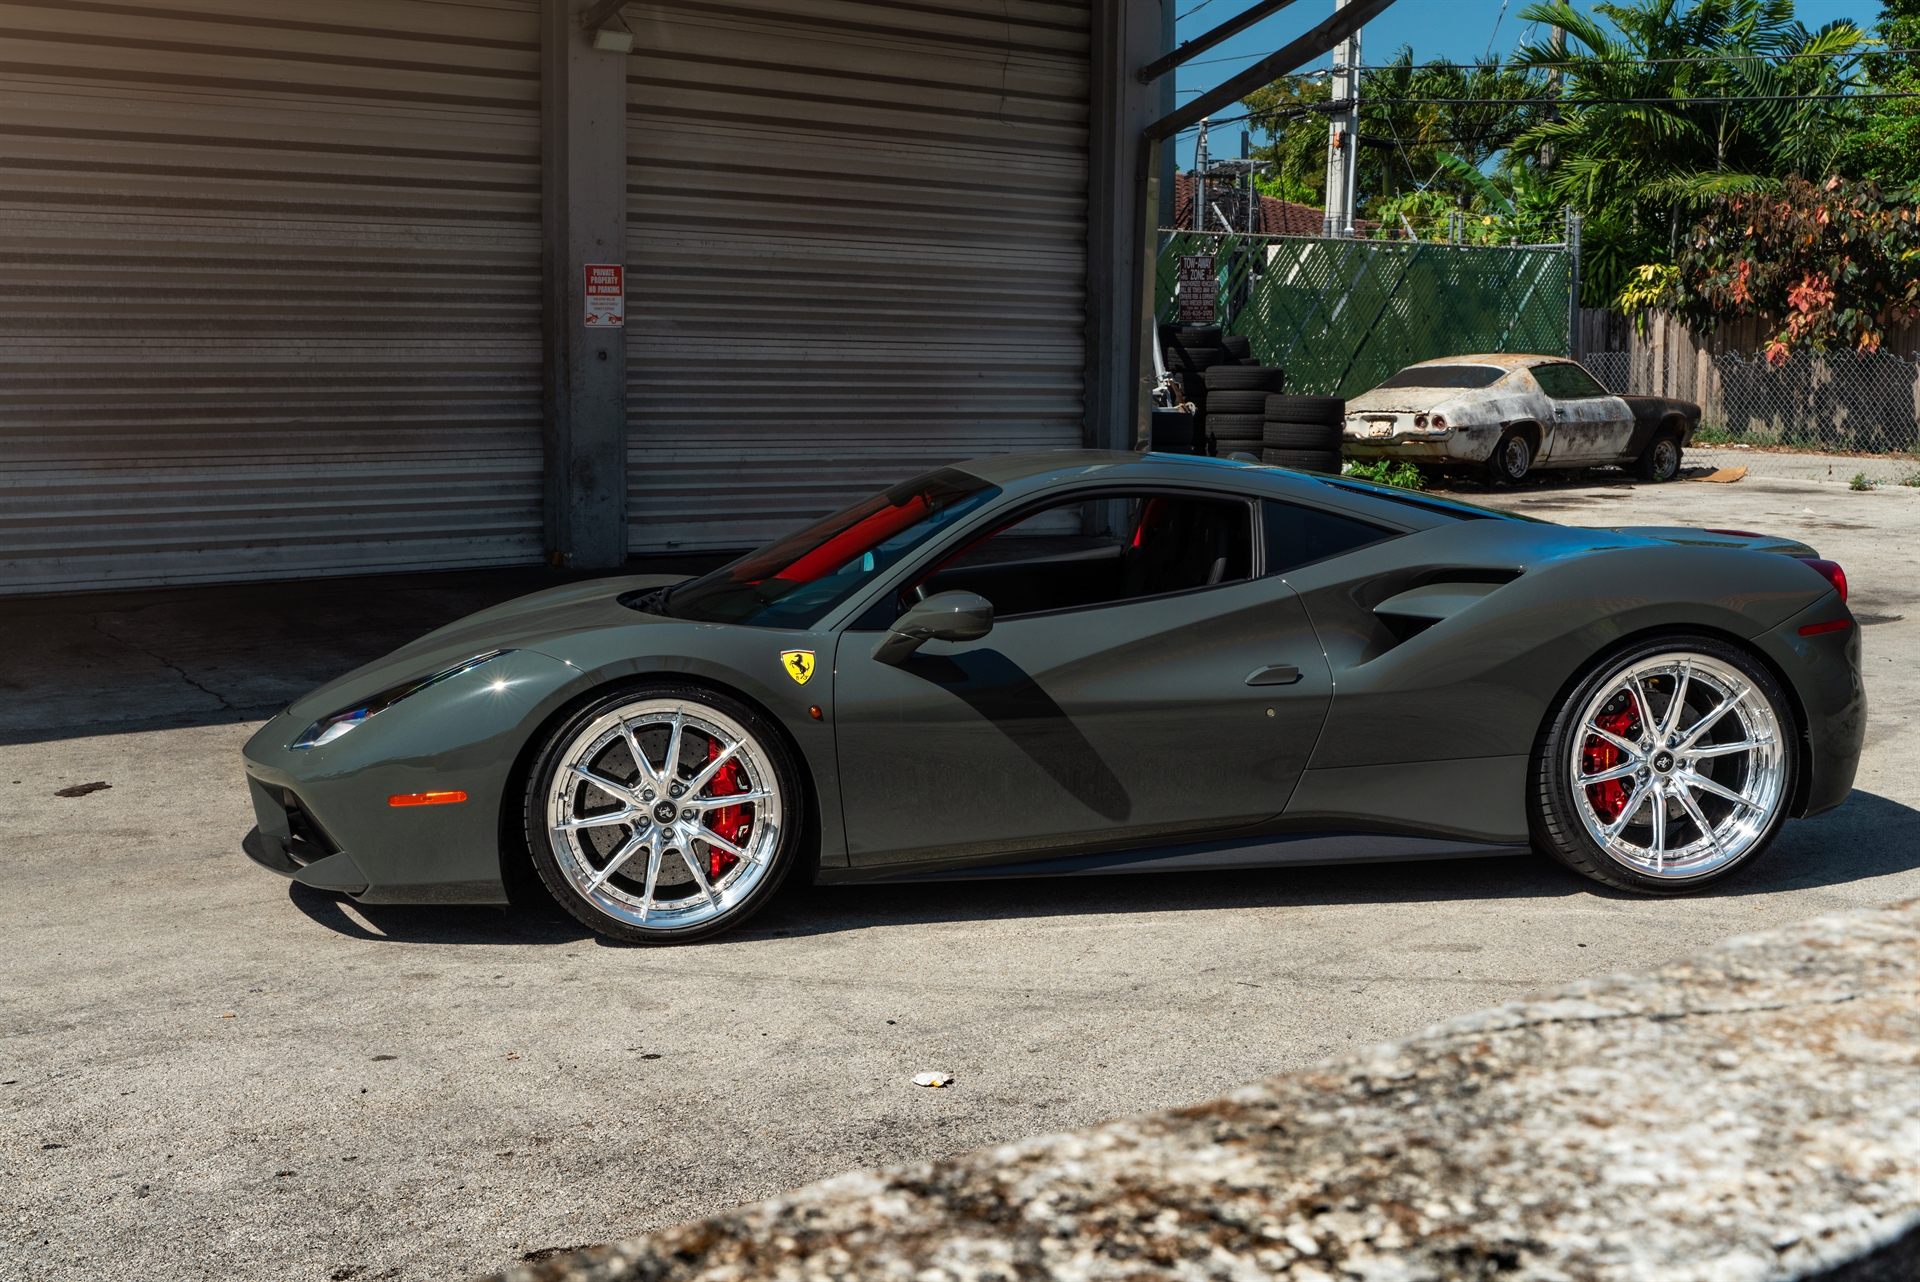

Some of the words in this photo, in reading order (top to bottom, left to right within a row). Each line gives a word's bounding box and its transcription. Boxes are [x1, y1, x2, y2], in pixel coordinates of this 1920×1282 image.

[1184, 258, 1212, 268] TOW-AWAY
[593, 268, 614, 276] PRIVATE
[1190, 269, 1205, 280] ZONE
[591, 276, 618, 284] PROPERTY
